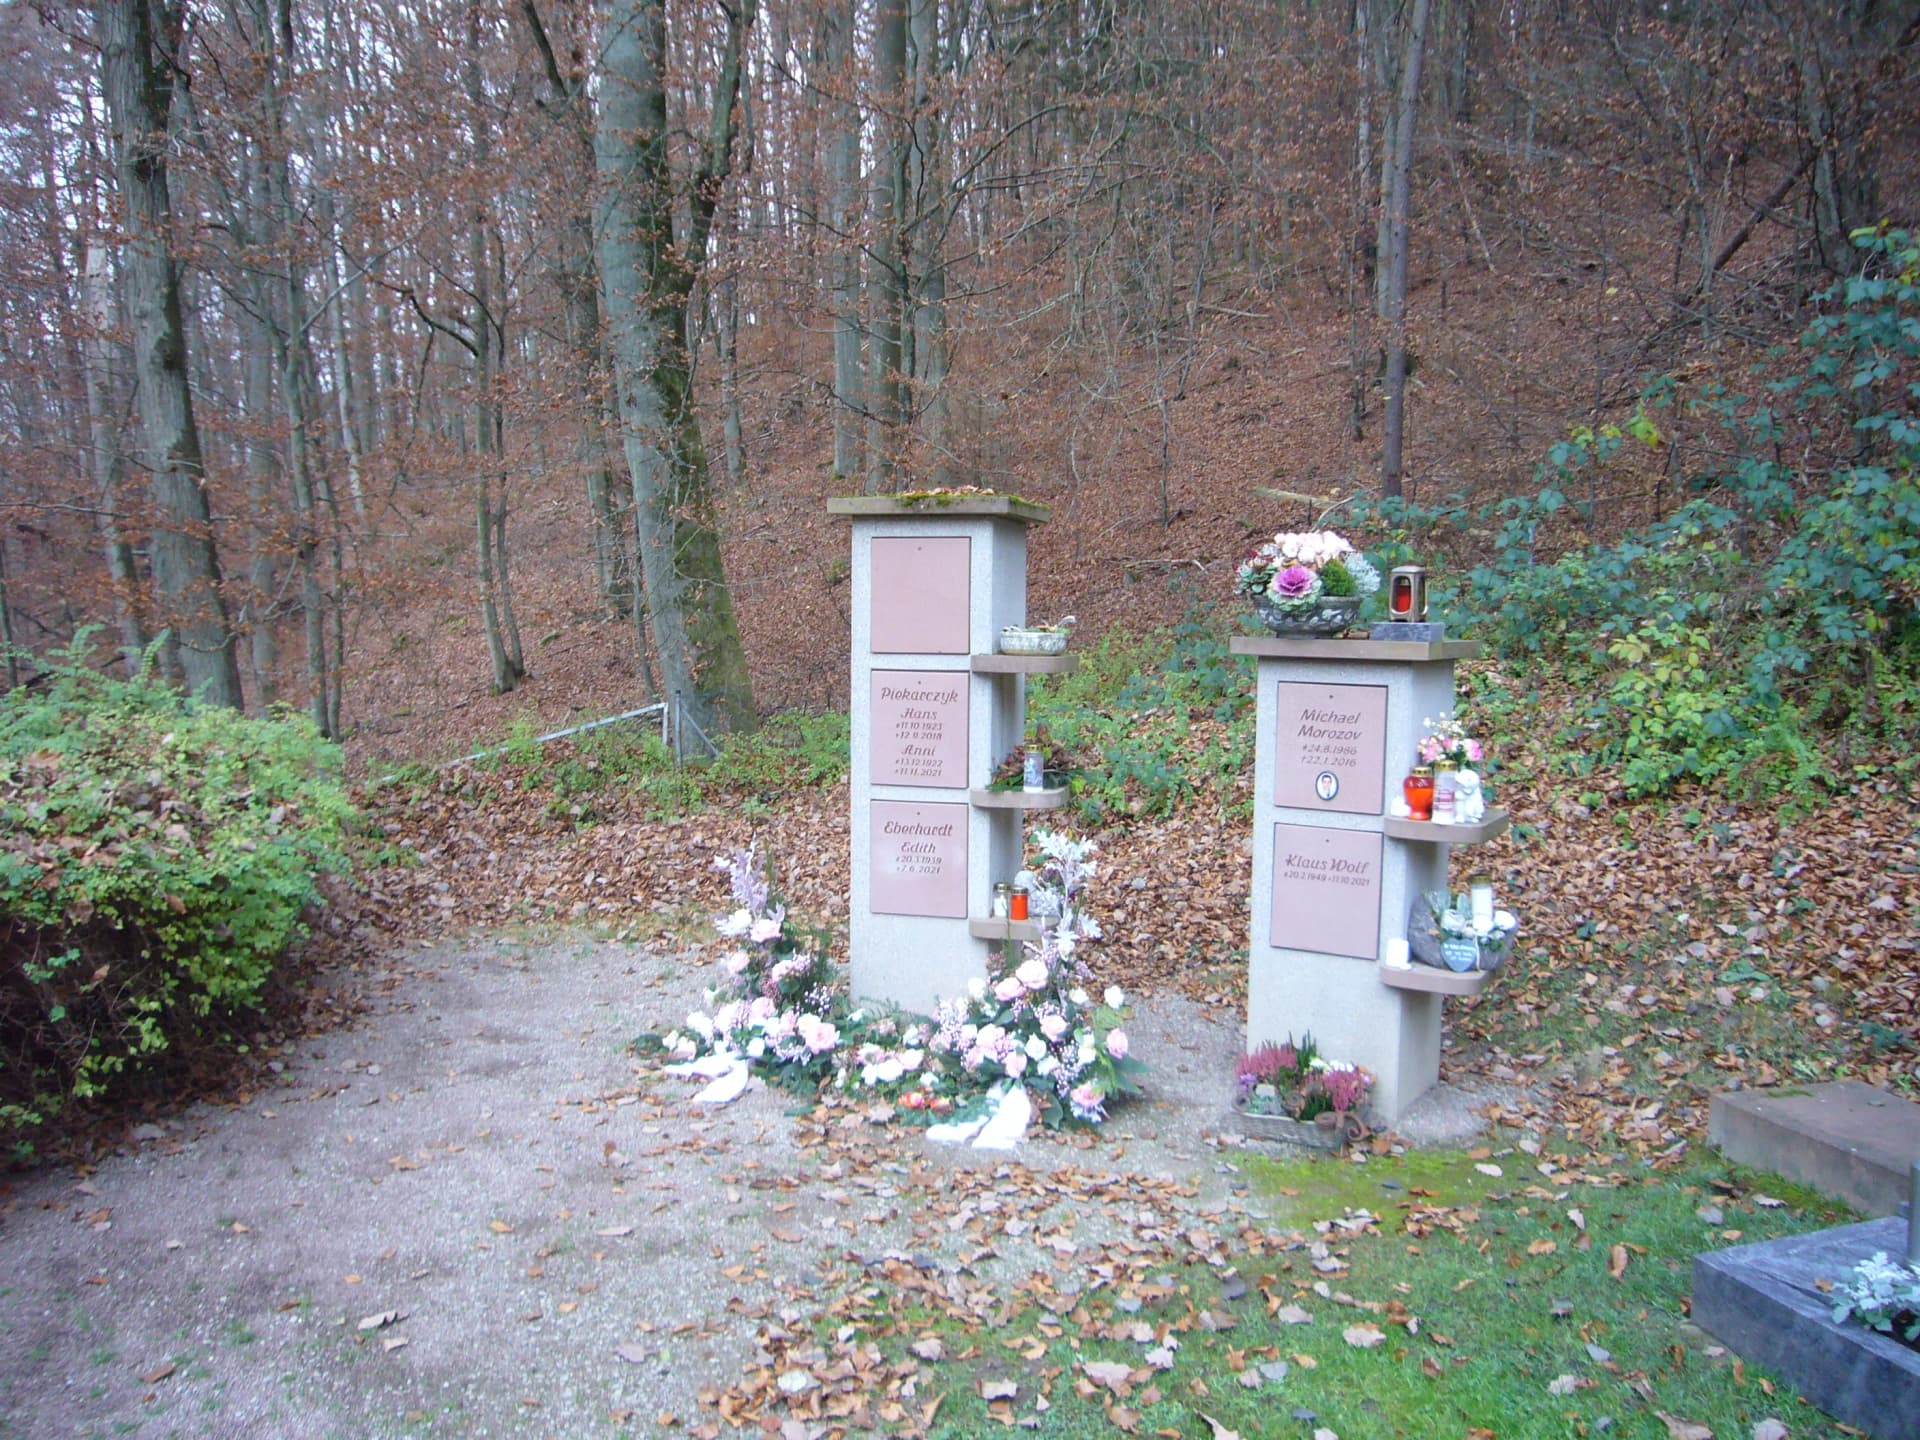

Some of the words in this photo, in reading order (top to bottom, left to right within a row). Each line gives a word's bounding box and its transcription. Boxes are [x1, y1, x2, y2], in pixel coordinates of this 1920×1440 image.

[881, 687, 959, 705] Piekarczyk
[900, 708, 938, 720] Hans
[1300, 709, 1361, 724] Michael
[1297, 725, 1362, 741] Morozov
[901, 744, 936, 757] Anni
[884, 821, 953, 837] Eberhardt
[901, 842, 936, 854] Edith
[1285, 854, 1328, 870] Klaus
[1330, 858, 1370, 874] Wolf
